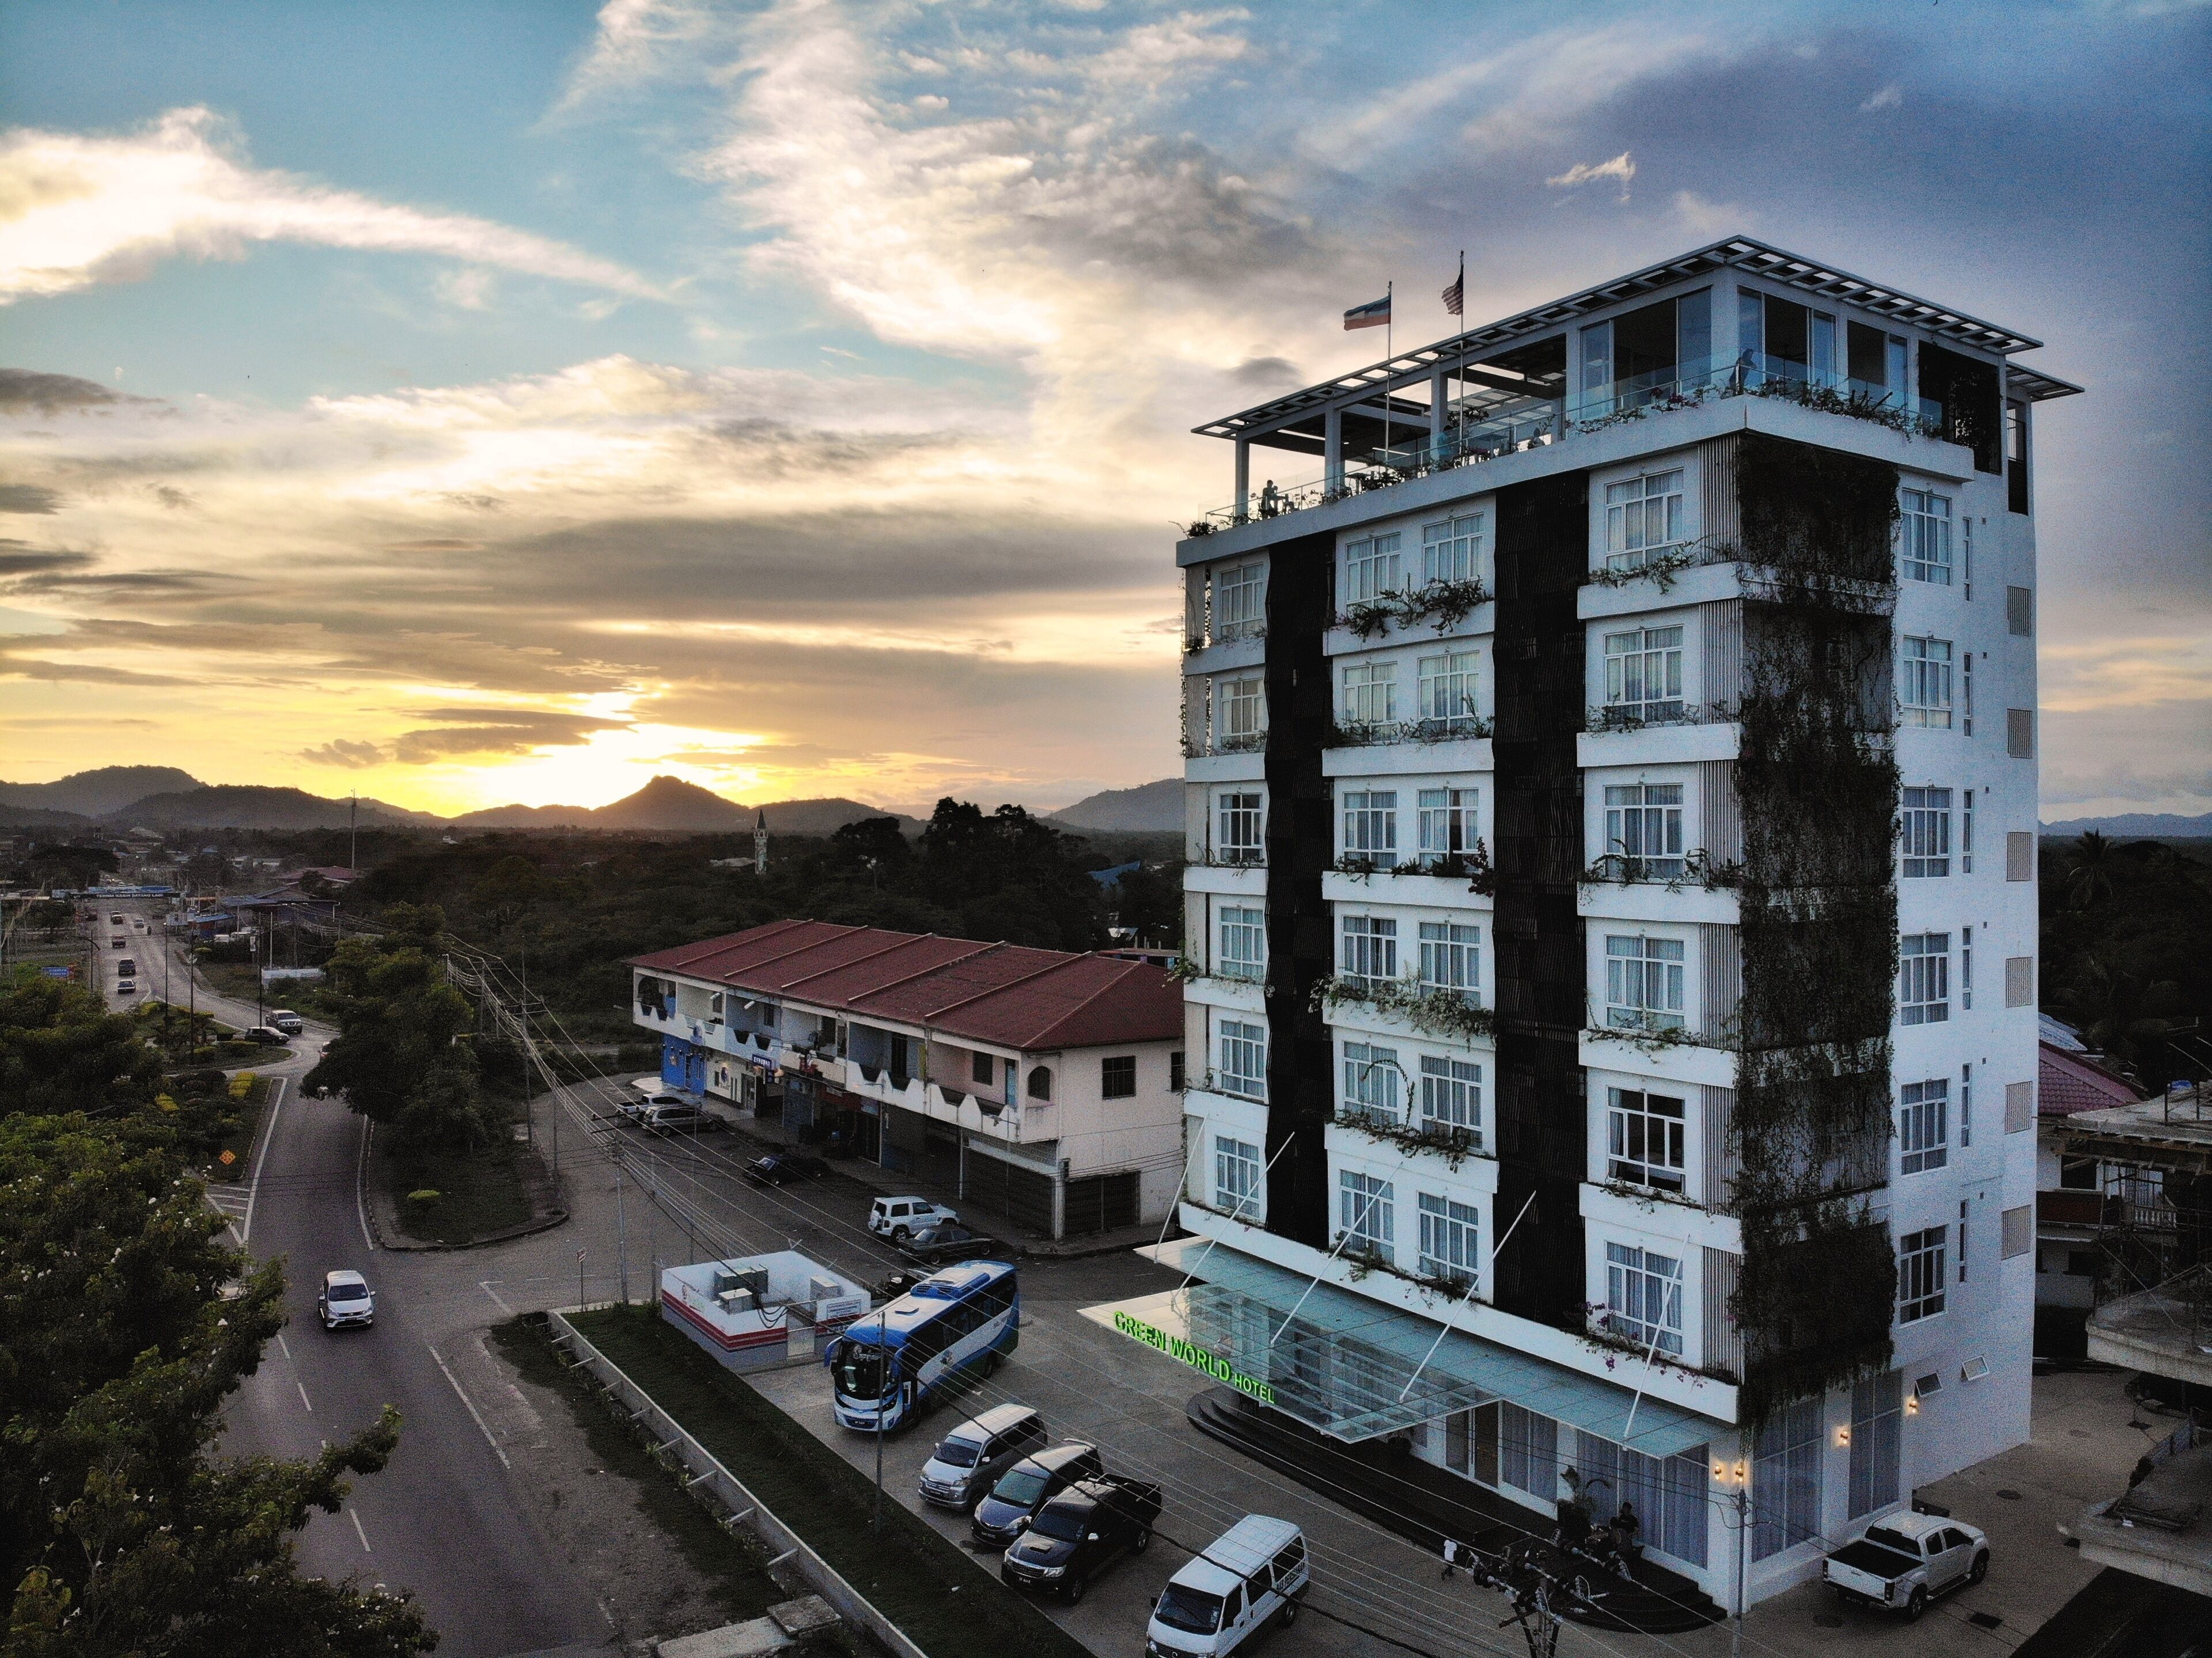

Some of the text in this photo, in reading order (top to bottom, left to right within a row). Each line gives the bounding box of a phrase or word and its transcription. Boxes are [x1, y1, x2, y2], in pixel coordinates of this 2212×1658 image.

[1113, 1310, 1275, 1405] GREEN WORLD HOTEL
